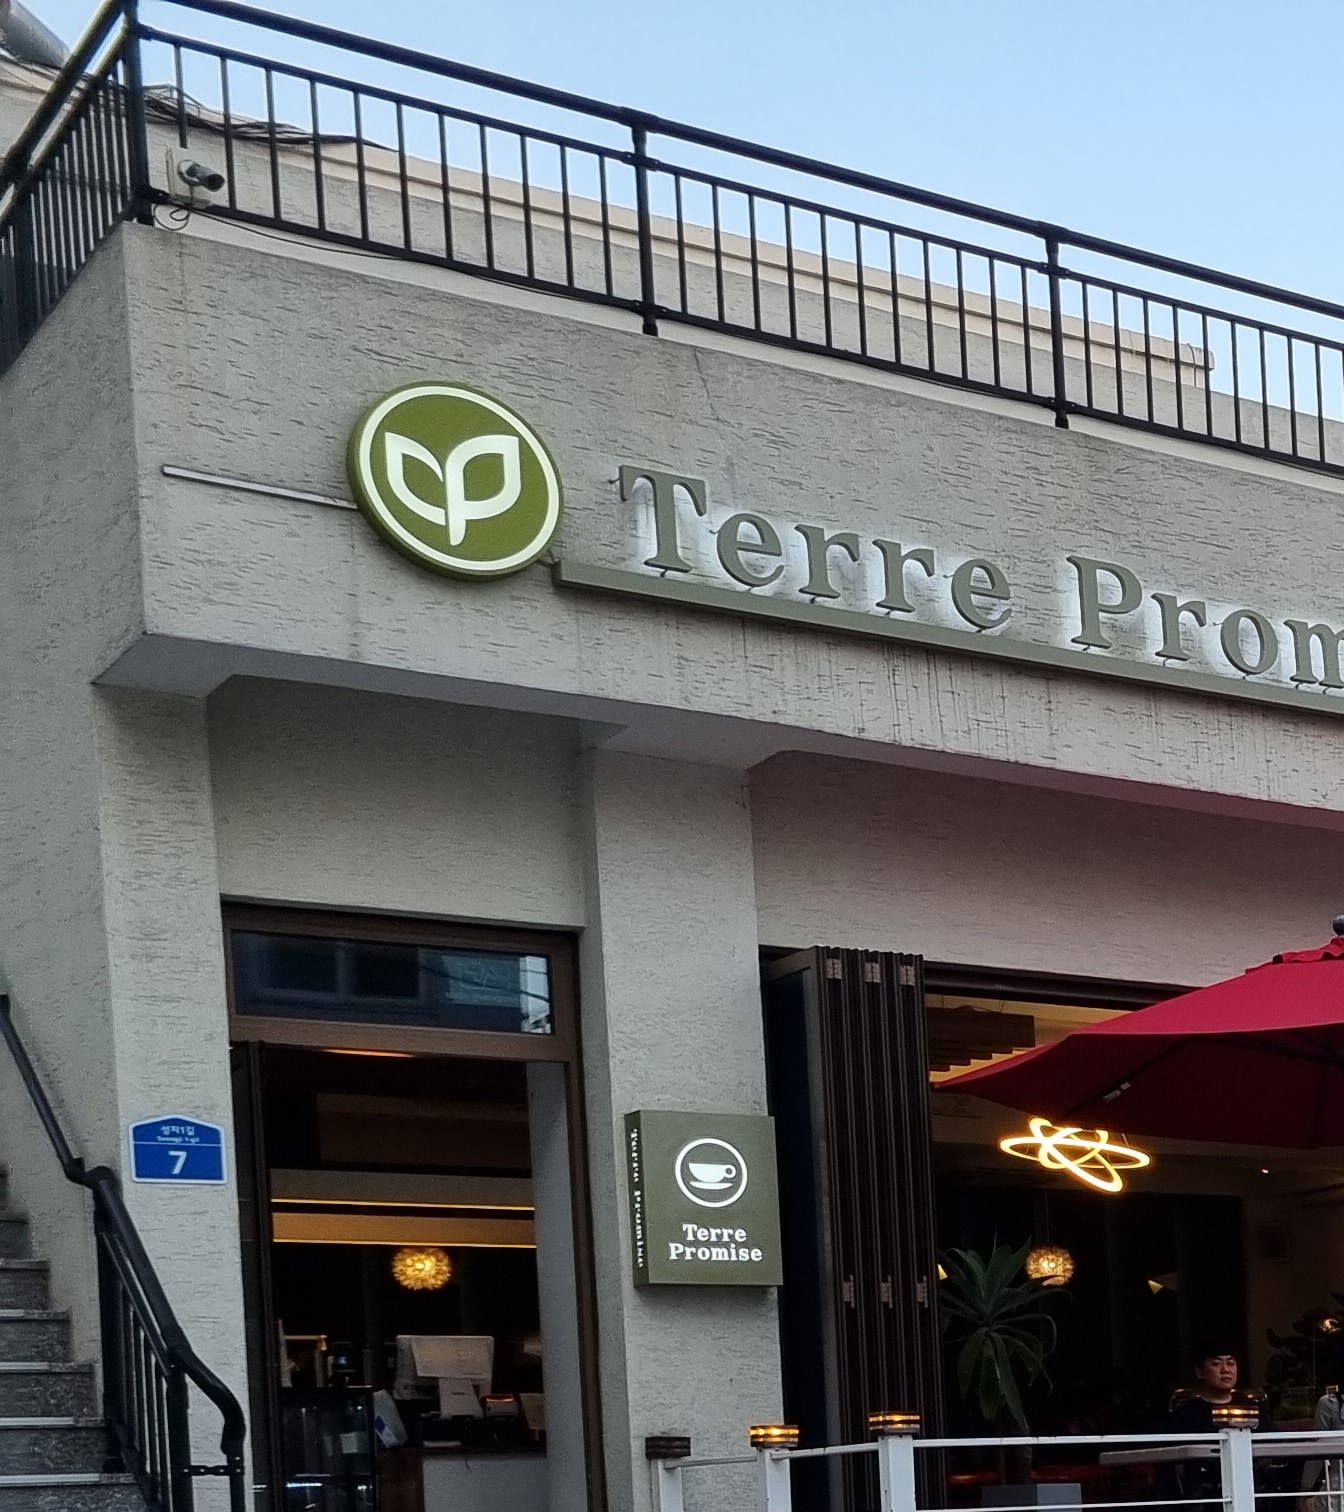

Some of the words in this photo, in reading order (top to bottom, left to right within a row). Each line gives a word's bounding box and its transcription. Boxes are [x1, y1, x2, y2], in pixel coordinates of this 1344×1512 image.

[619, 463, 1014, 632] Terre
[168, 1150, 187, 1175] 7
[682, 1223, 748, 1243] Terre
[668, 1242, 764, 1262] Promise
